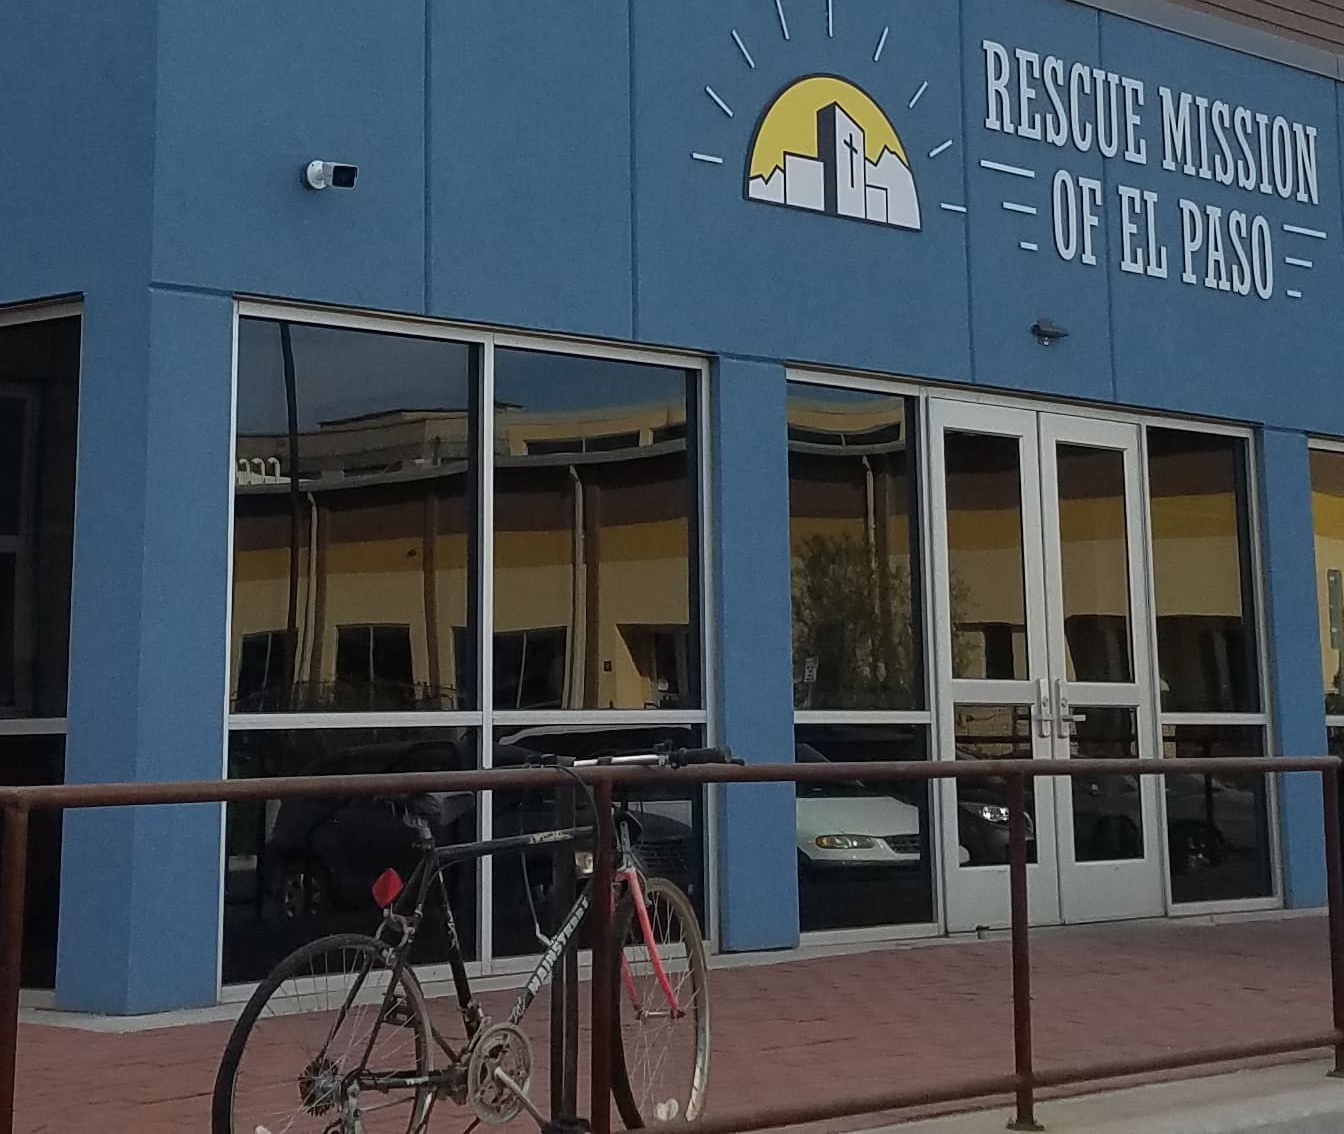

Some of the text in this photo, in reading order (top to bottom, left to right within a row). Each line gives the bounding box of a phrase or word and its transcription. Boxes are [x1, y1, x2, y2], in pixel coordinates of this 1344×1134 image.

[982, 39, 1319, 205] RESCUE MISSION
[1053, 169, 1274, 300] OF EL PASO
